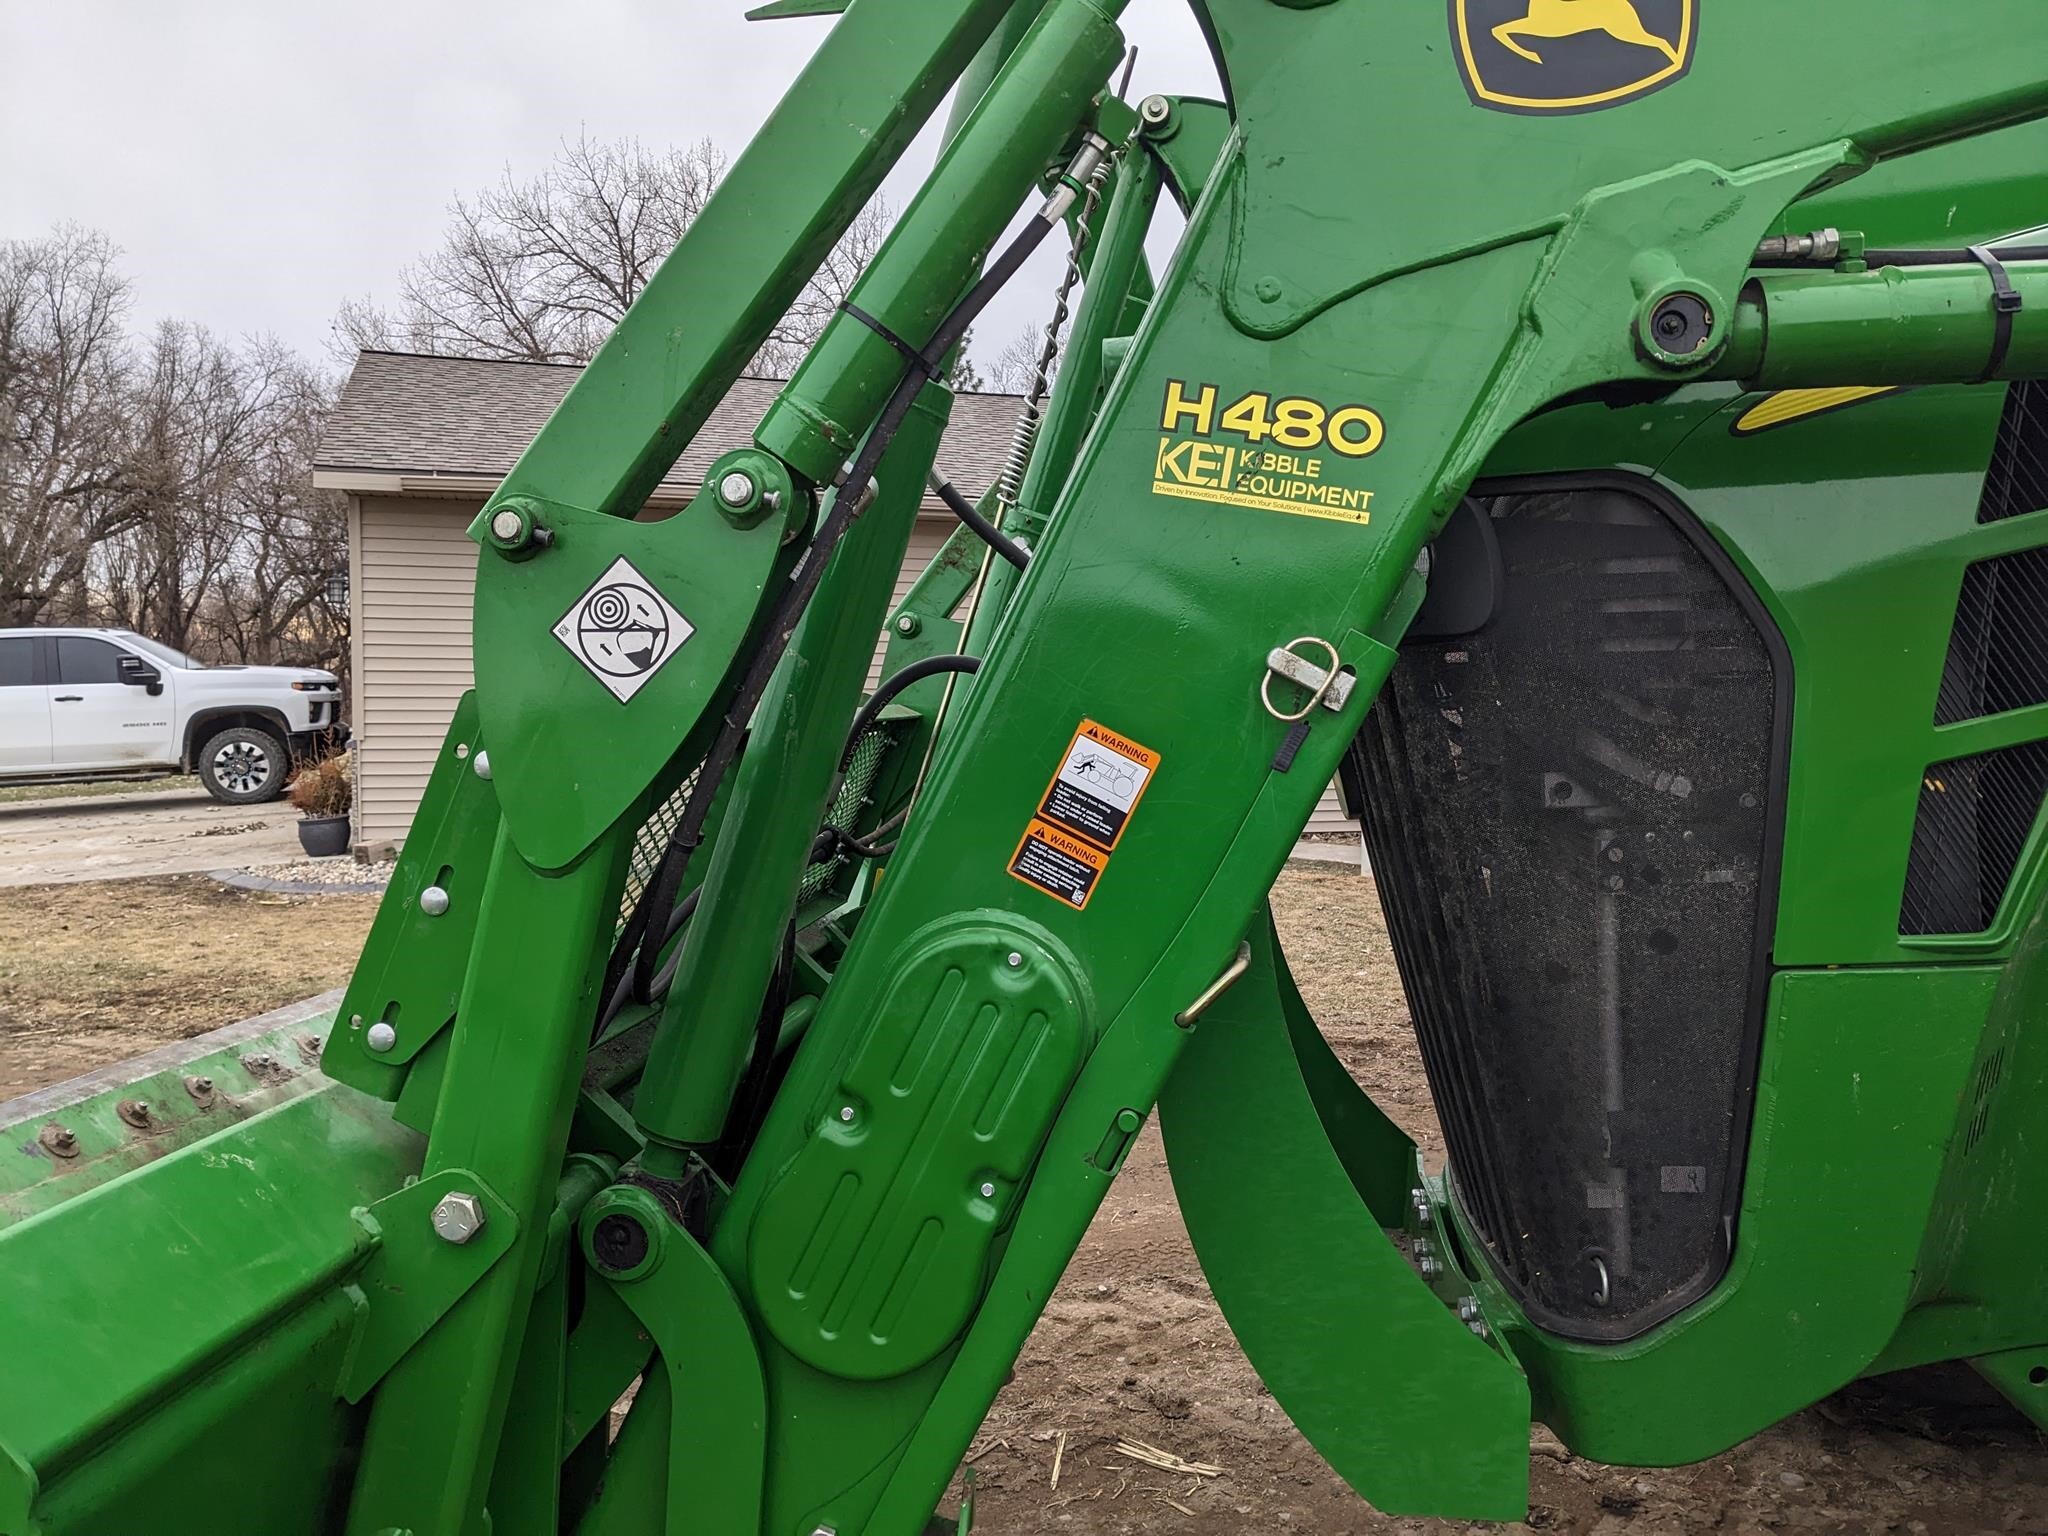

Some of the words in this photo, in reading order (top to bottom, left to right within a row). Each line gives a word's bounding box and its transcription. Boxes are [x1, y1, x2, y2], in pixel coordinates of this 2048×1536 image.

[1160, 379, 1386, 458] H480
[1154, 437, 1236, 489] KEI
[1239, 449, 1322, 478] KBBLE
[1100, 732, 1150, 763] WARNING
[1050, 834, 1098, 865] WARNING
